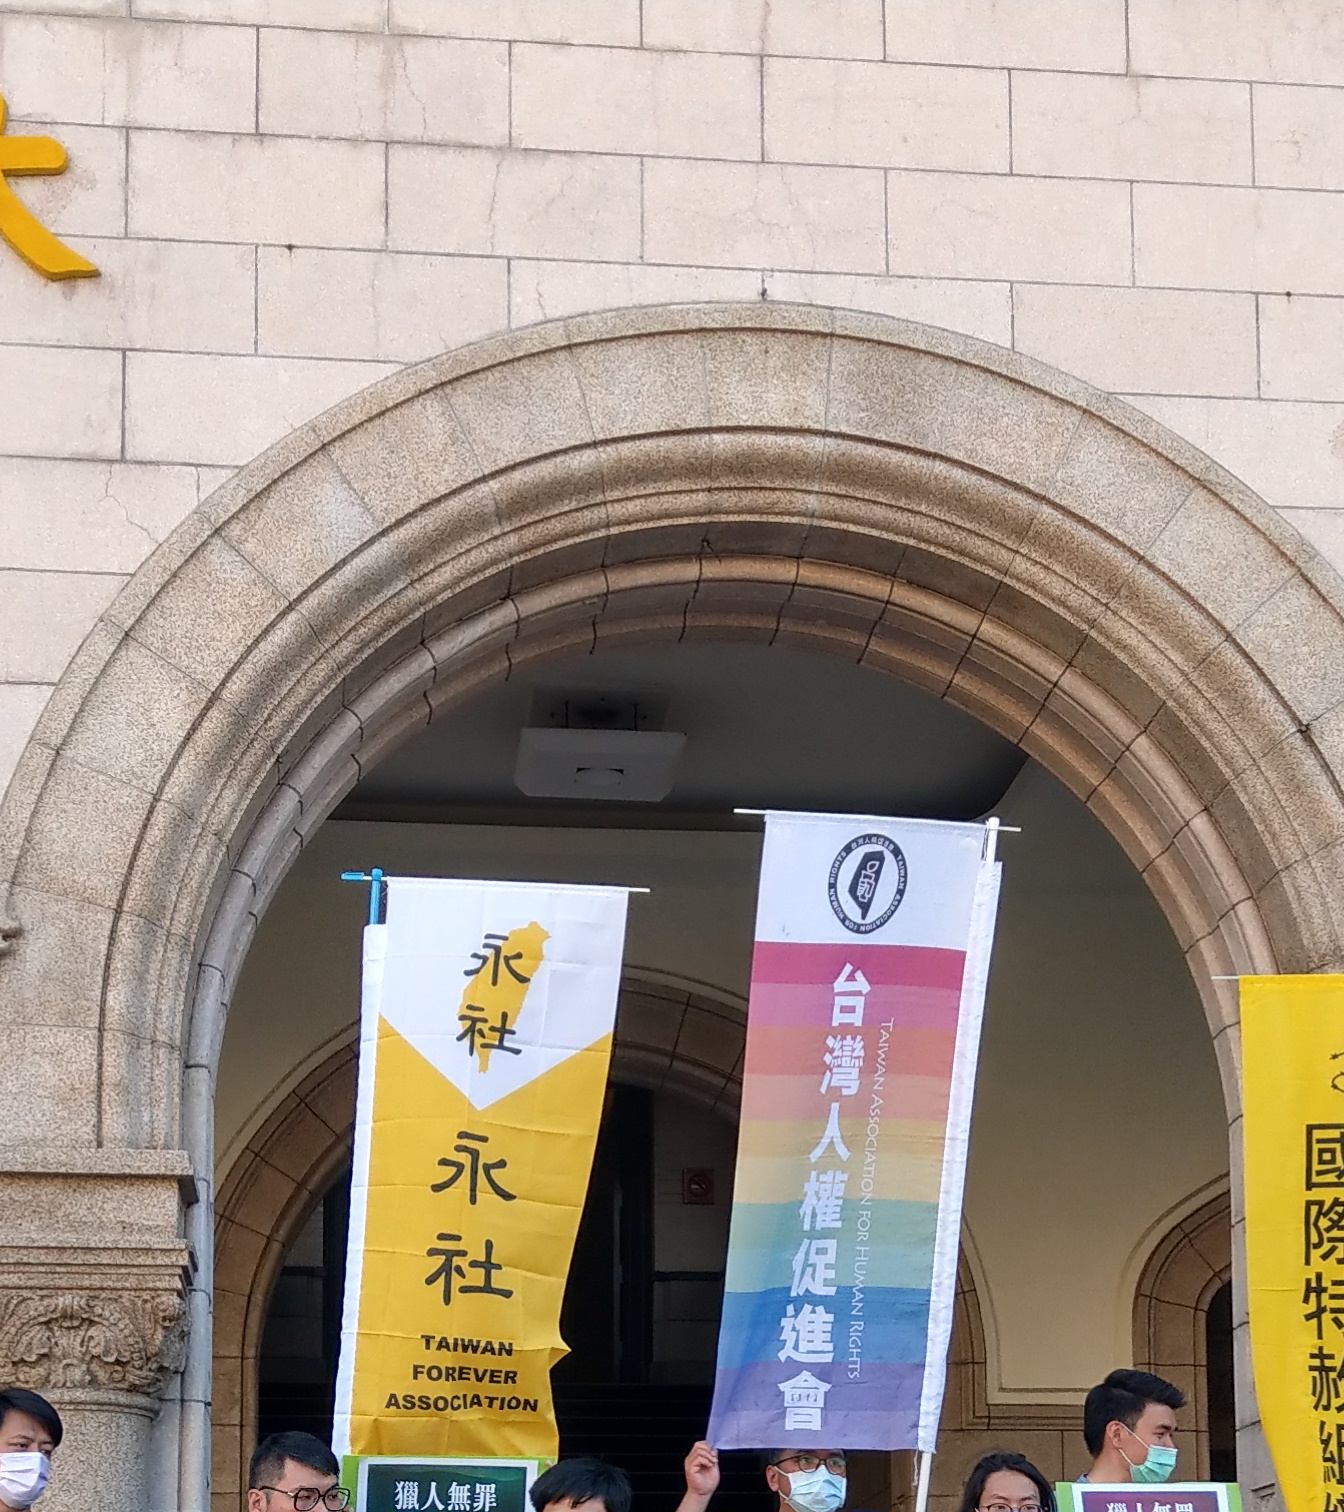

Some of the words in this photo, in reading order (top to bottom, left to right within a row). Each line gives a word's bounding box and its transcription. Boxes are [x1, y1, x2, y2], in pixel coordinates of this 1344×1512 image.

[456, 932, 531, 1058] 永社
[871, 1017, 895, 1090] TAIWAN
[860, 1094, 884, 1205] ASSOCIATION
[424, 1131, 518, 1307] 永社
[777, 962, 871, 1432] 台灣人權促進會
[856, 1210, 871, 1242] FOR
[850, 1246, 870, 1316] HUMAN
[411, 1363, 518, 1386] FOREVER
[420, 1334, 514, 1358] TAIWAN
[847, 1321, 865, 1379] RIGHTS
[384, 1392, 540, 1414] ASSOCIATION
[394, 1480, 498, 1512] 獵人無罪
